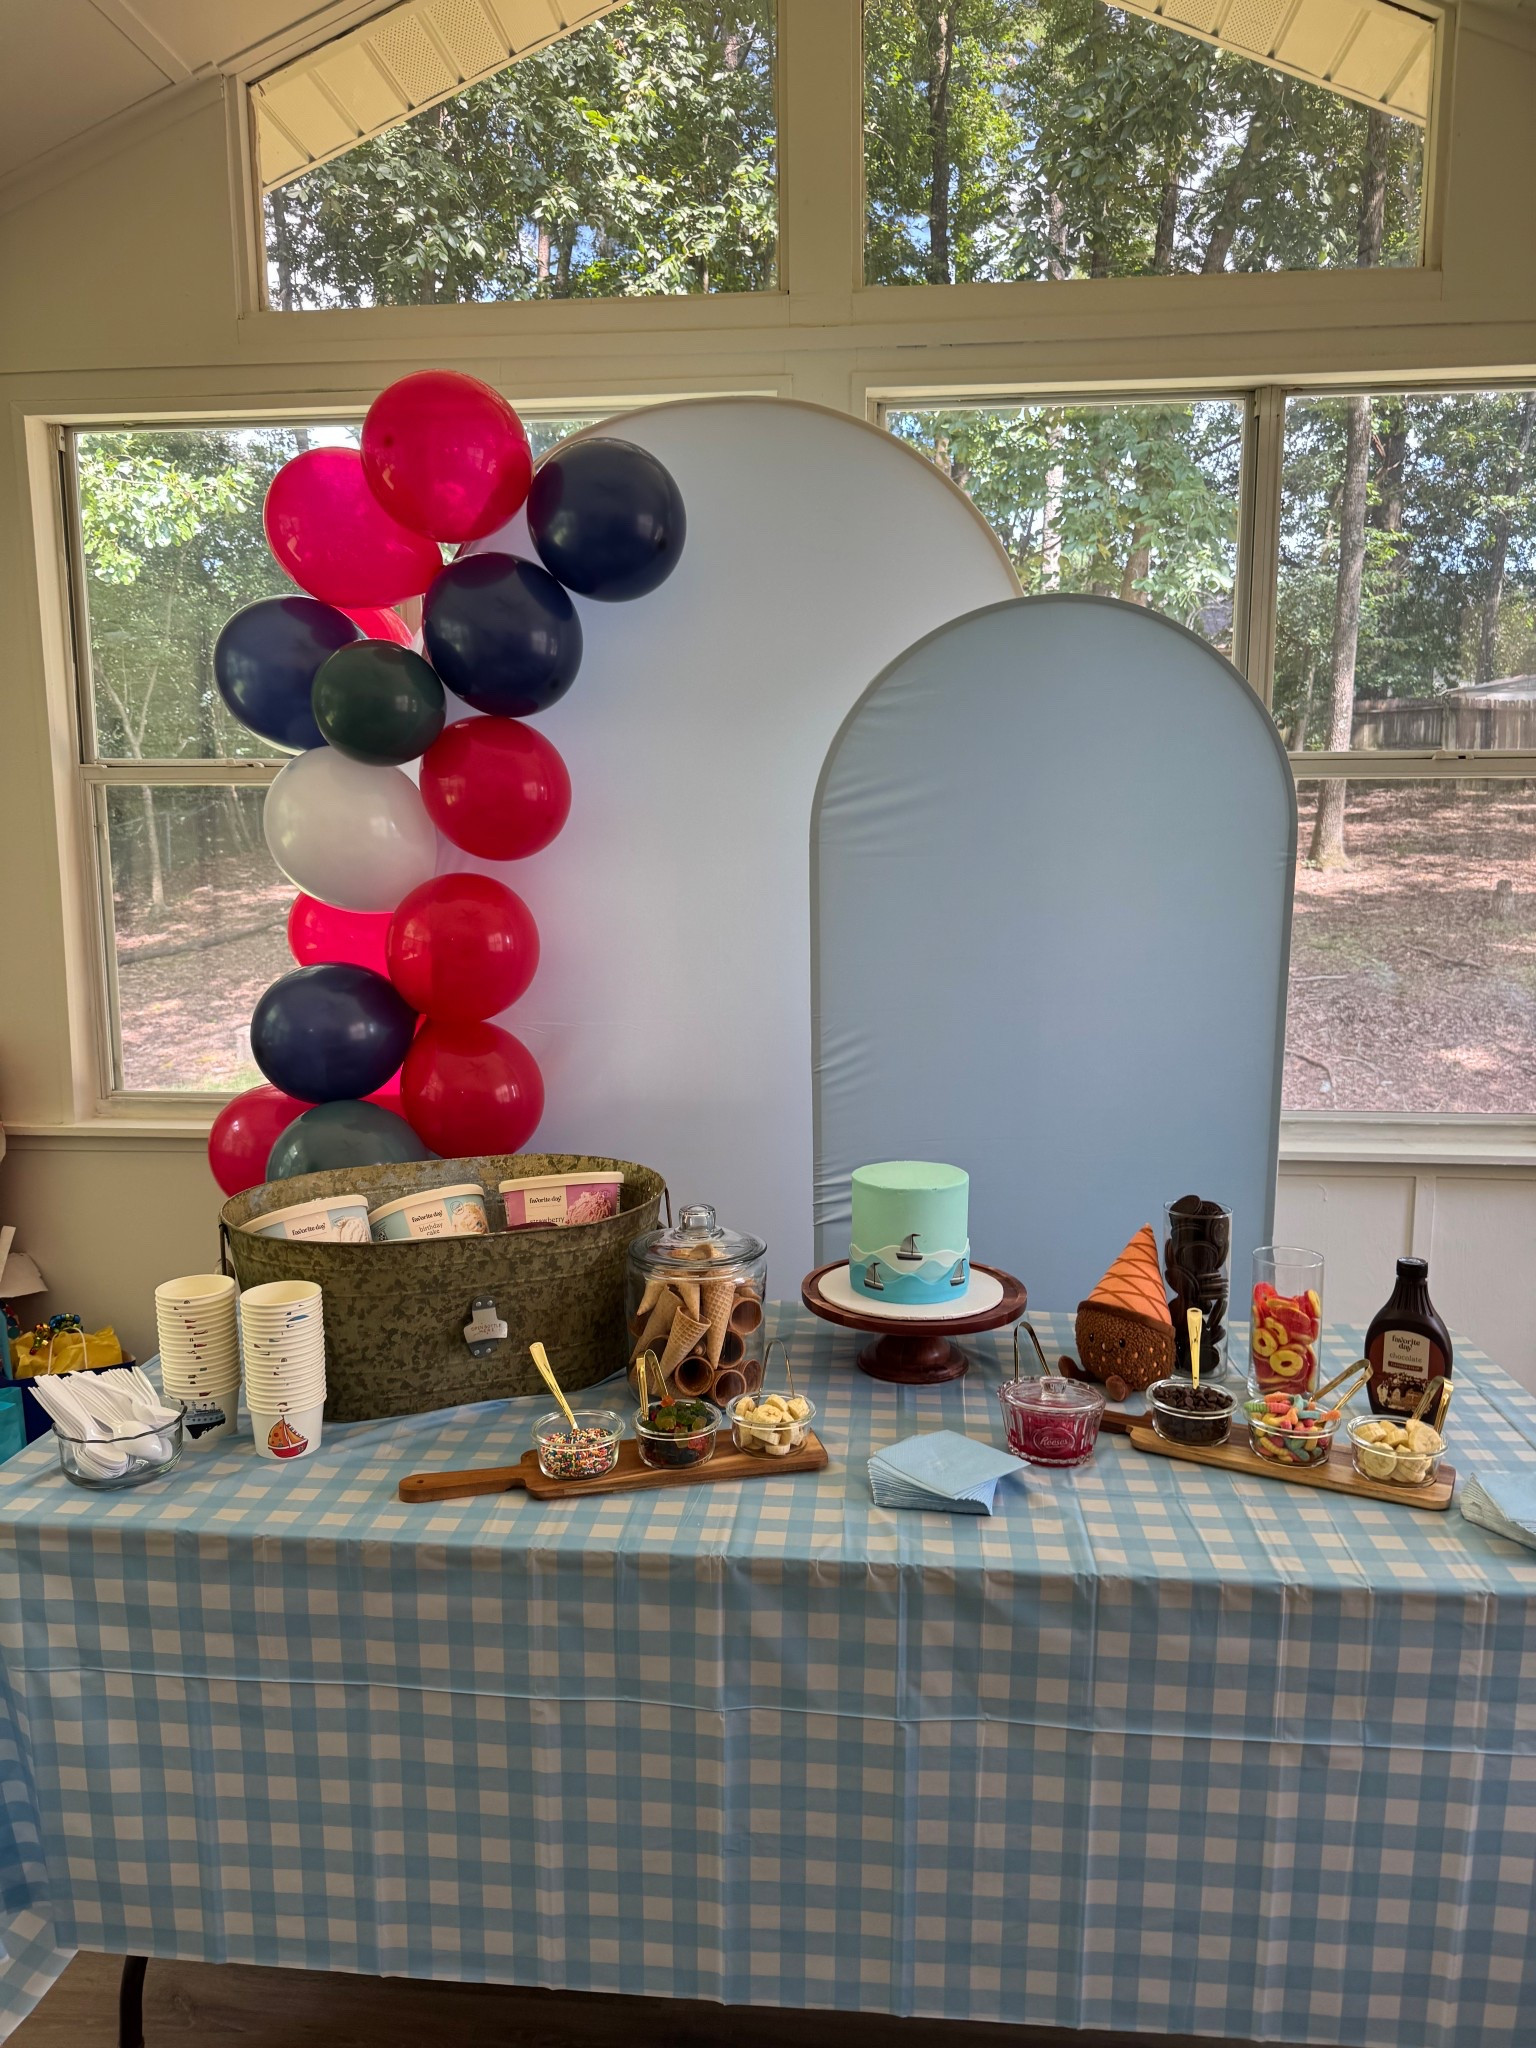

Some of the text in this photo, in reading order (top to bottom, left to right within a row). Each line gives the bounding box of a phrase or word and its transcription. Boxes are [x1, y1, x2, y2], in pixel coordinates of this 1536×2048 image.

[529, 1195, 562, 1204] favorite day
[411, 1210, 443, 1223] favorite day
[291, 1222, 326, 1236] favorite day
[418, 1222, 443, 1233] birthday
[426, 1229, 441, 1237] cake
[1391, 1335, 1421, 1346] favorite
[1398, 1342, 1413, 1352] day
[1389, 1353, 1423, 1363] chocolate
